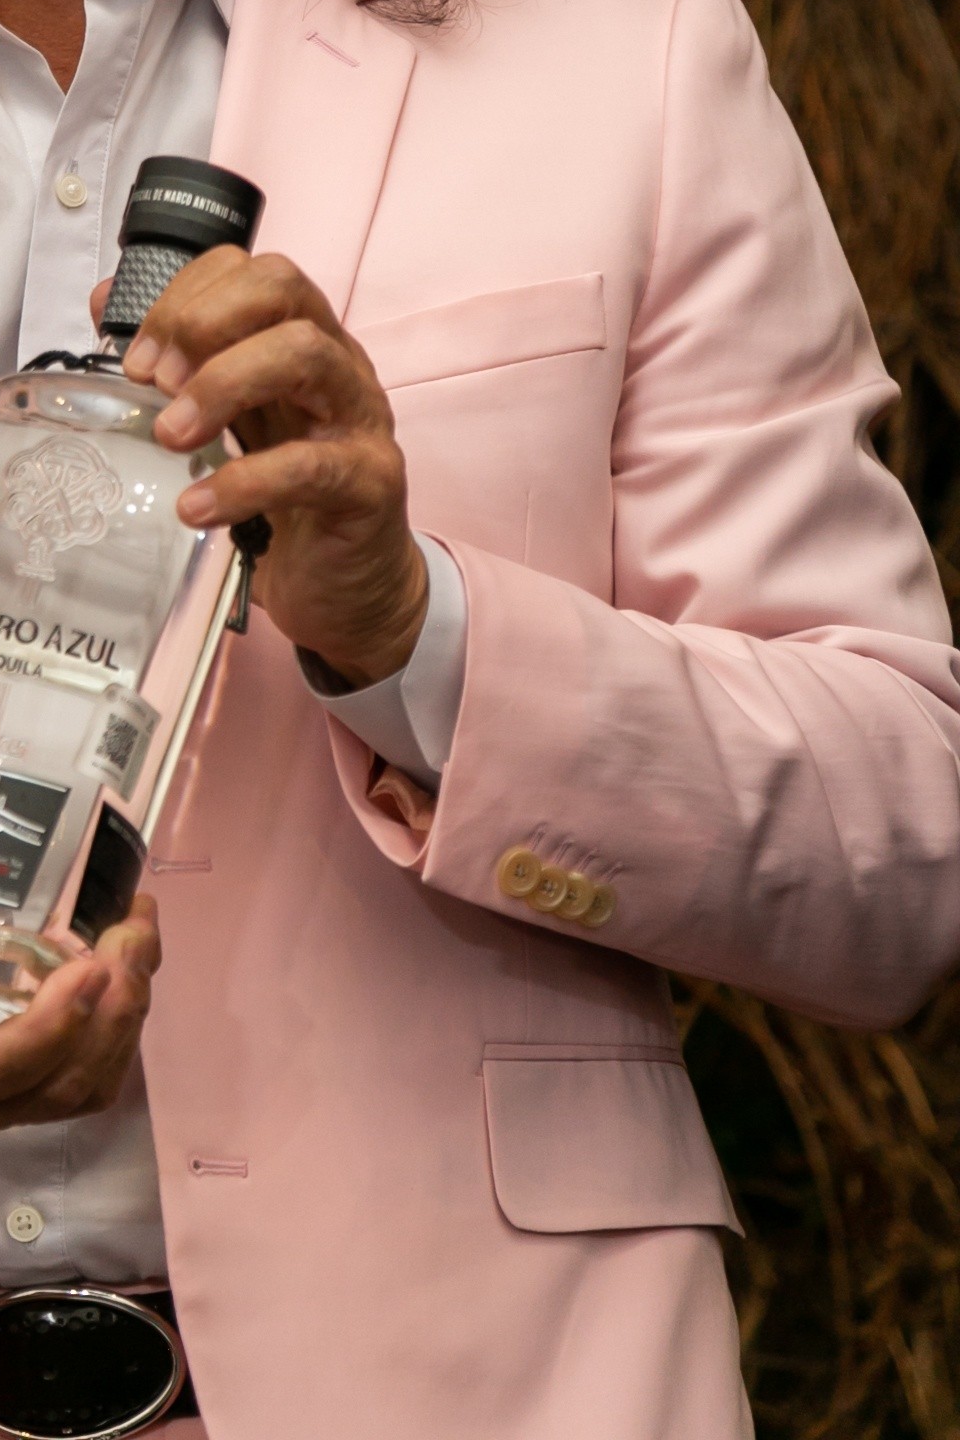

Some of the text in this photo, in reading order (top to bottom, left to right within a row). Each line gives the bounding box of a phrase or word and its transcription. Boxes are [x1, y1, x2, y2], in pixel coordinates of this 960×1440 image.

[152, 188, 164, 201] DE
[163, 189, 193, 207] MARCO
[192, 195, 230, 219] ANTONIO
[43, 625, 120, 671] AZUL
